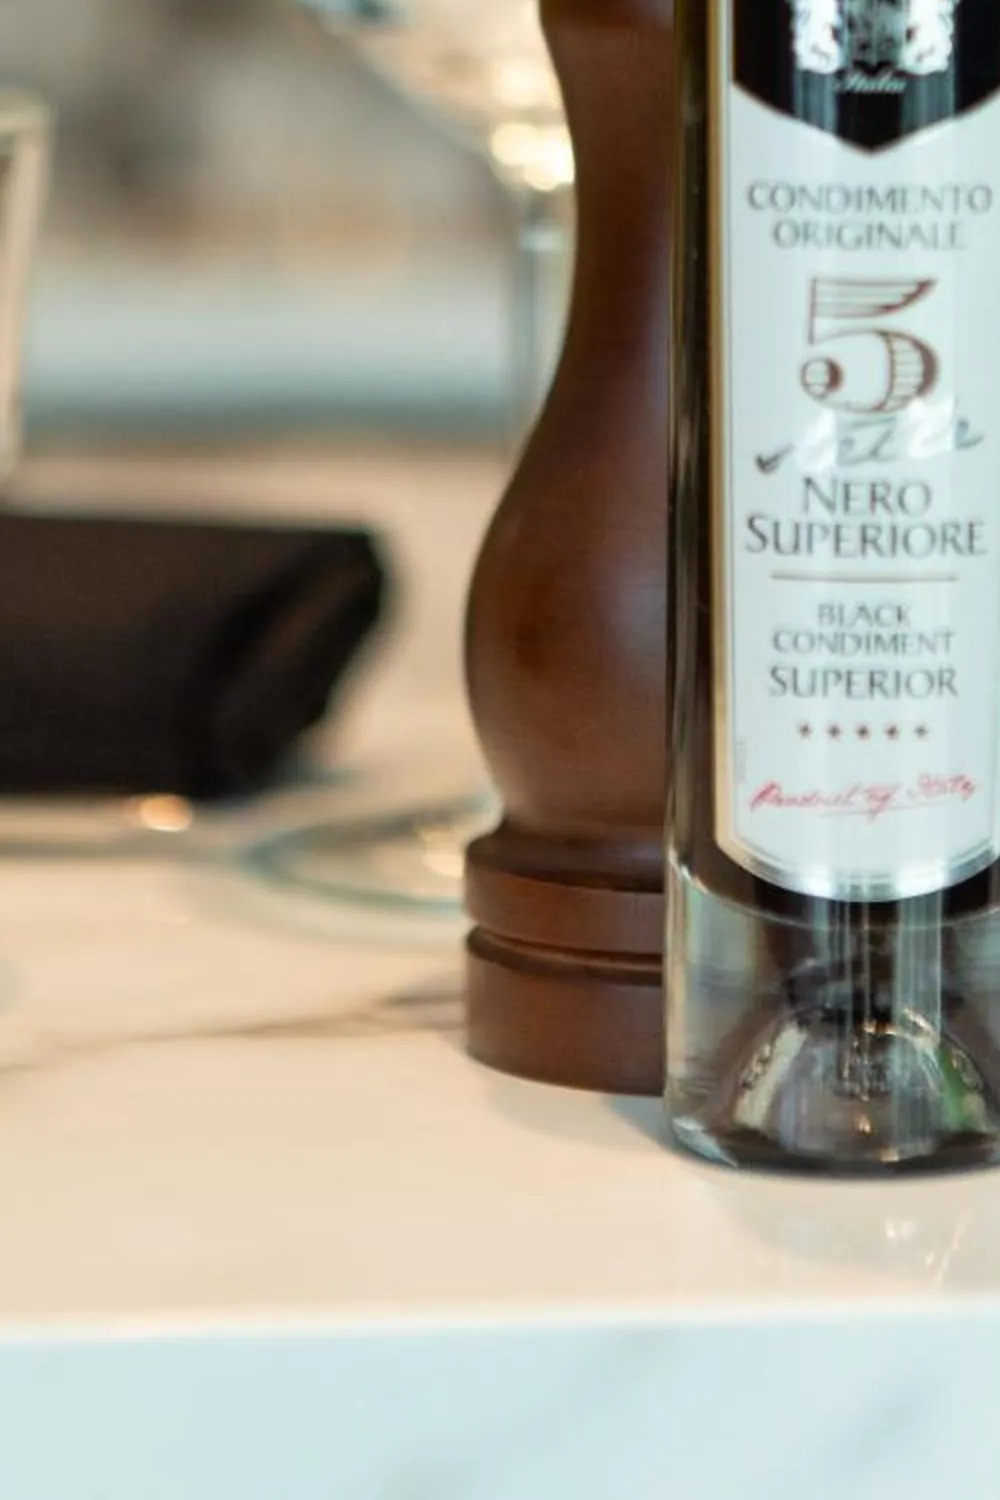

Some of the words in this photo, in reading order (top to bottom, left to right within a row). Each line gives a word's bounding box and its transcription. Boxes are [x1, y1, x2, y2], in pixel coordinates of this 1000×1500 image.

[747, 180, 993, 214] CONDIMENTO
[771, 219, 968, 251] ORIGINALE
[800, 275, 941, 414] 5
[801, 475, 933, 517] NERO
[745, 512, 989, 560] SUPERIORE
[817, 601, 913, 629] BLACK
[771, 629, 955, 658] CONDIMENT
[768, 664, 960, 700] SUPERIOR
